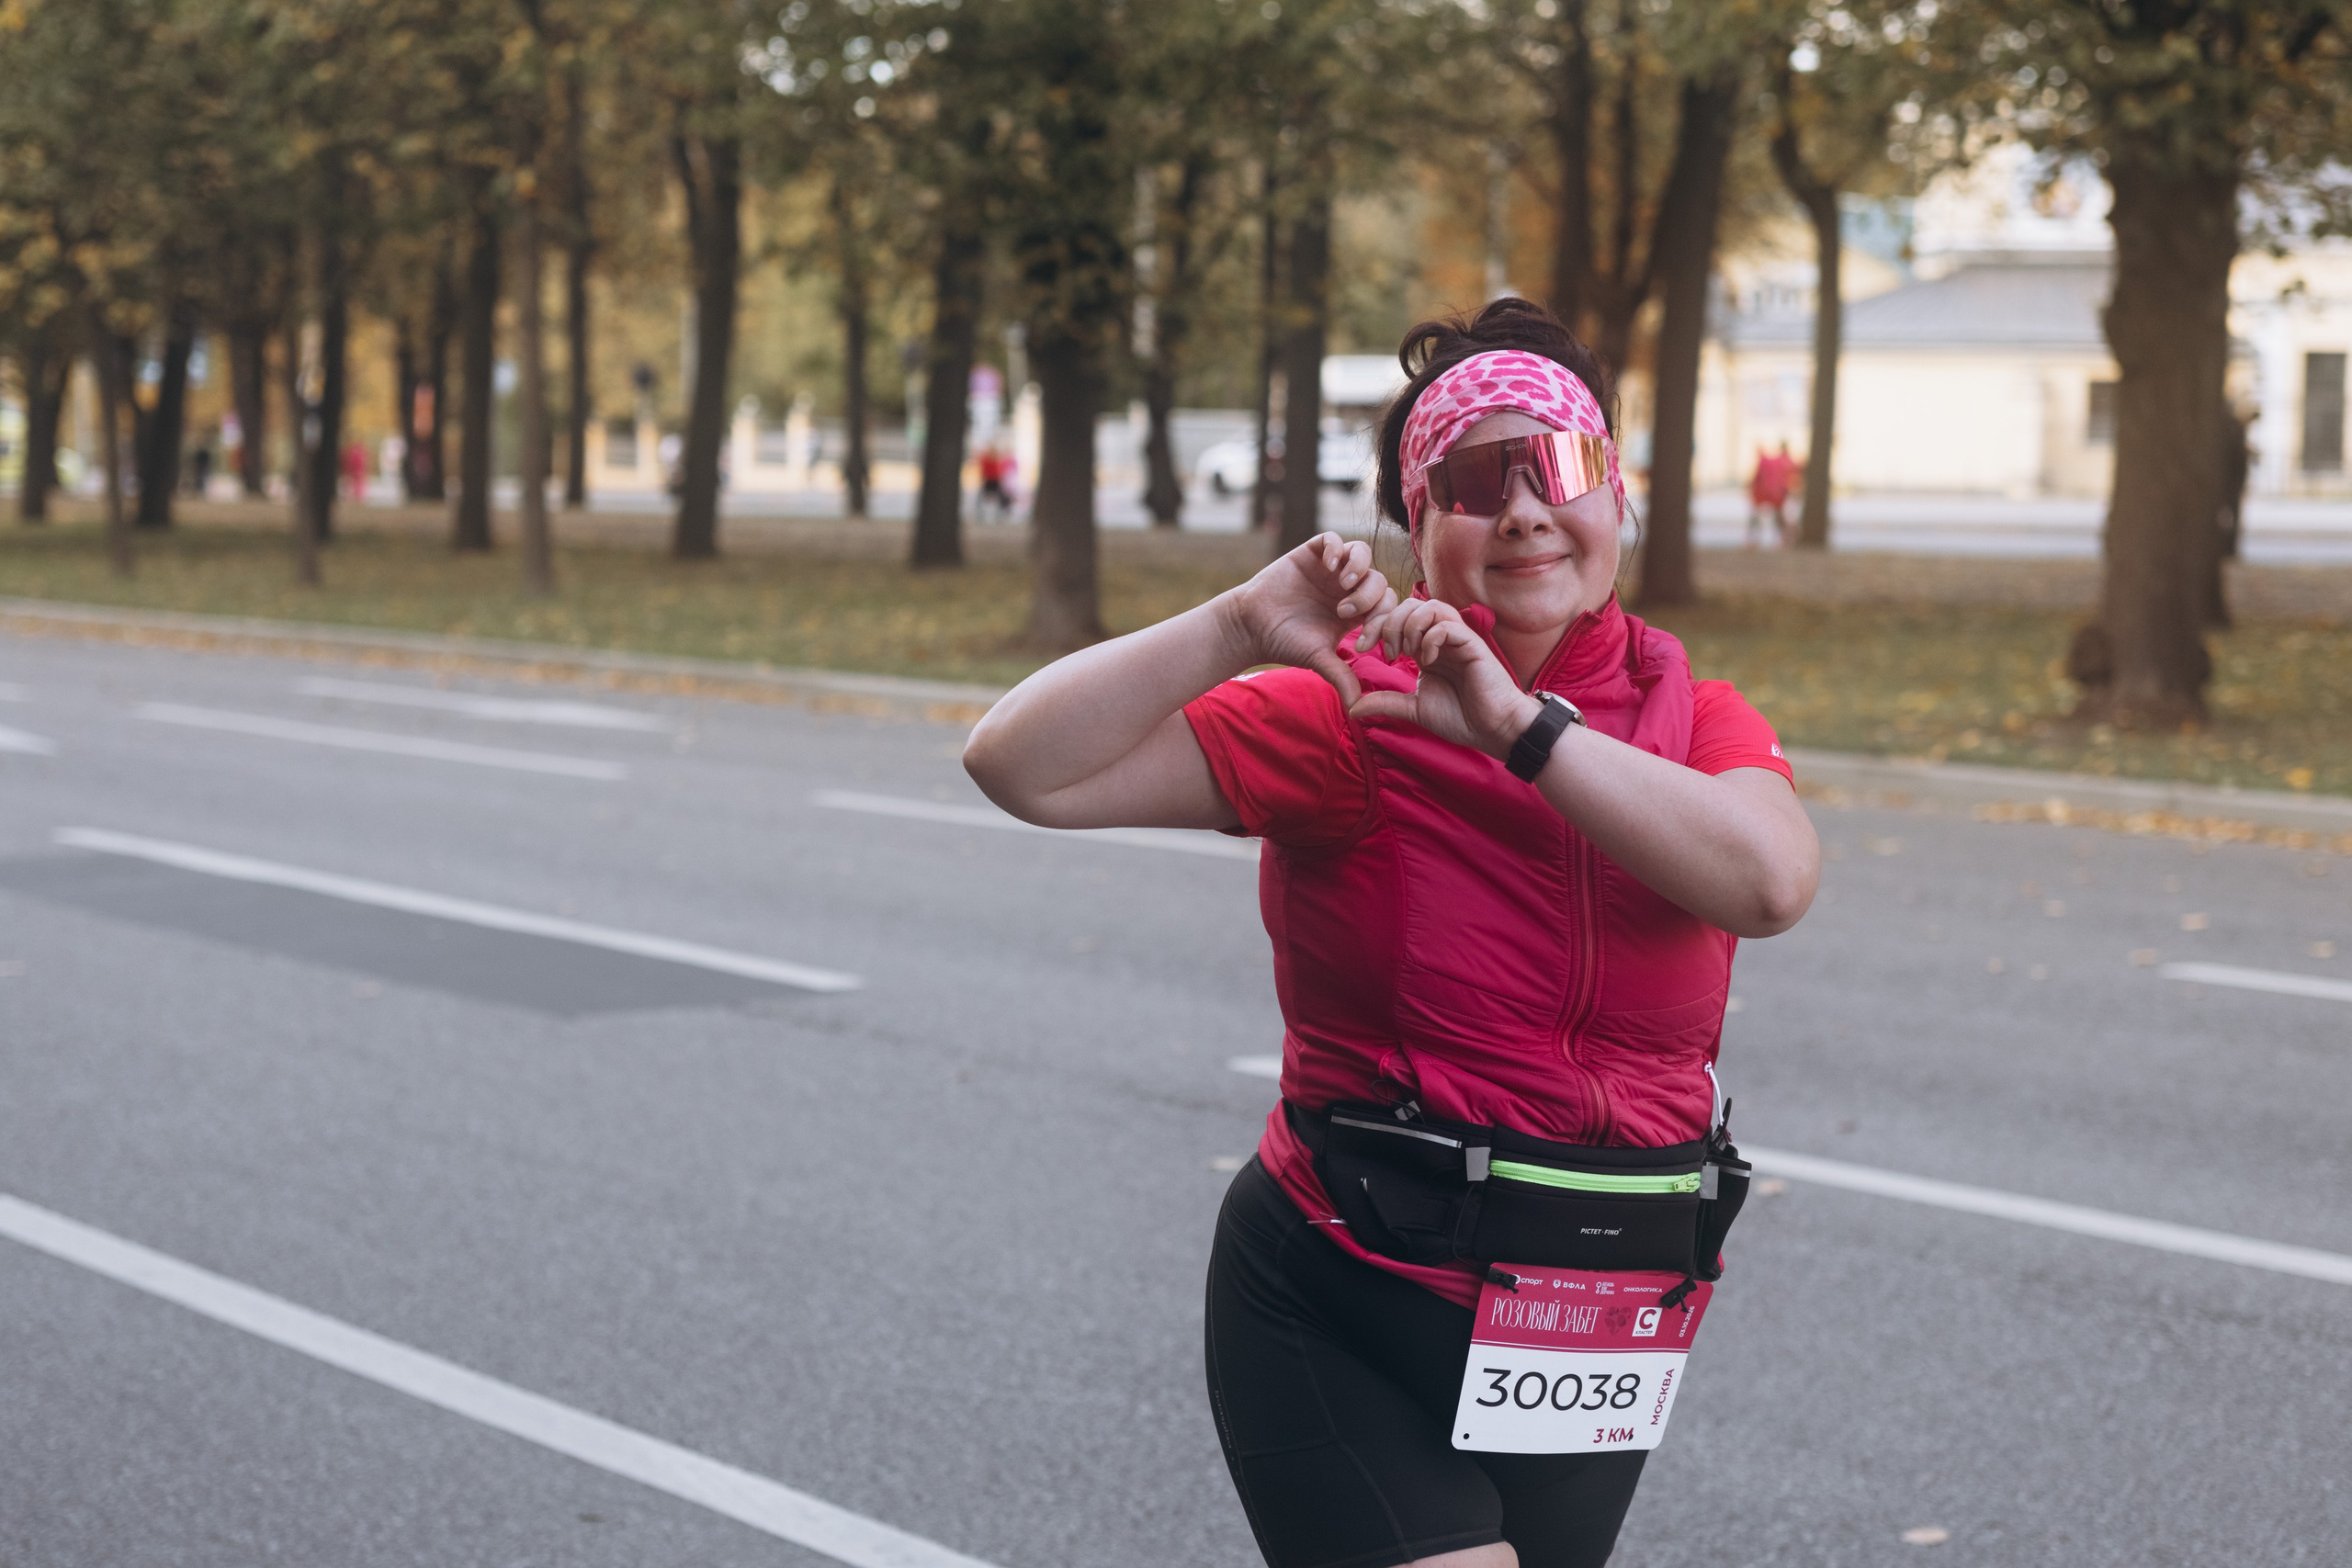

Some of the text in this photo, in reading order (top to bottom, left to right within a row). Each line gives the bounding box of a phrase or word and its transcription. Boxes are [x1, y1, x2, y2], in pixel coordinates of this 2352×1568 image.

[1491, 1297, 1602, 1334] РОЗОВЫЙ ЗАБЕГ
[1476, 1368, 1641, 1411] 30038
[1650, 1369, 1675, 1425] МОСКВА
[1593, 1427, 1634, 1443] 3 КМ
